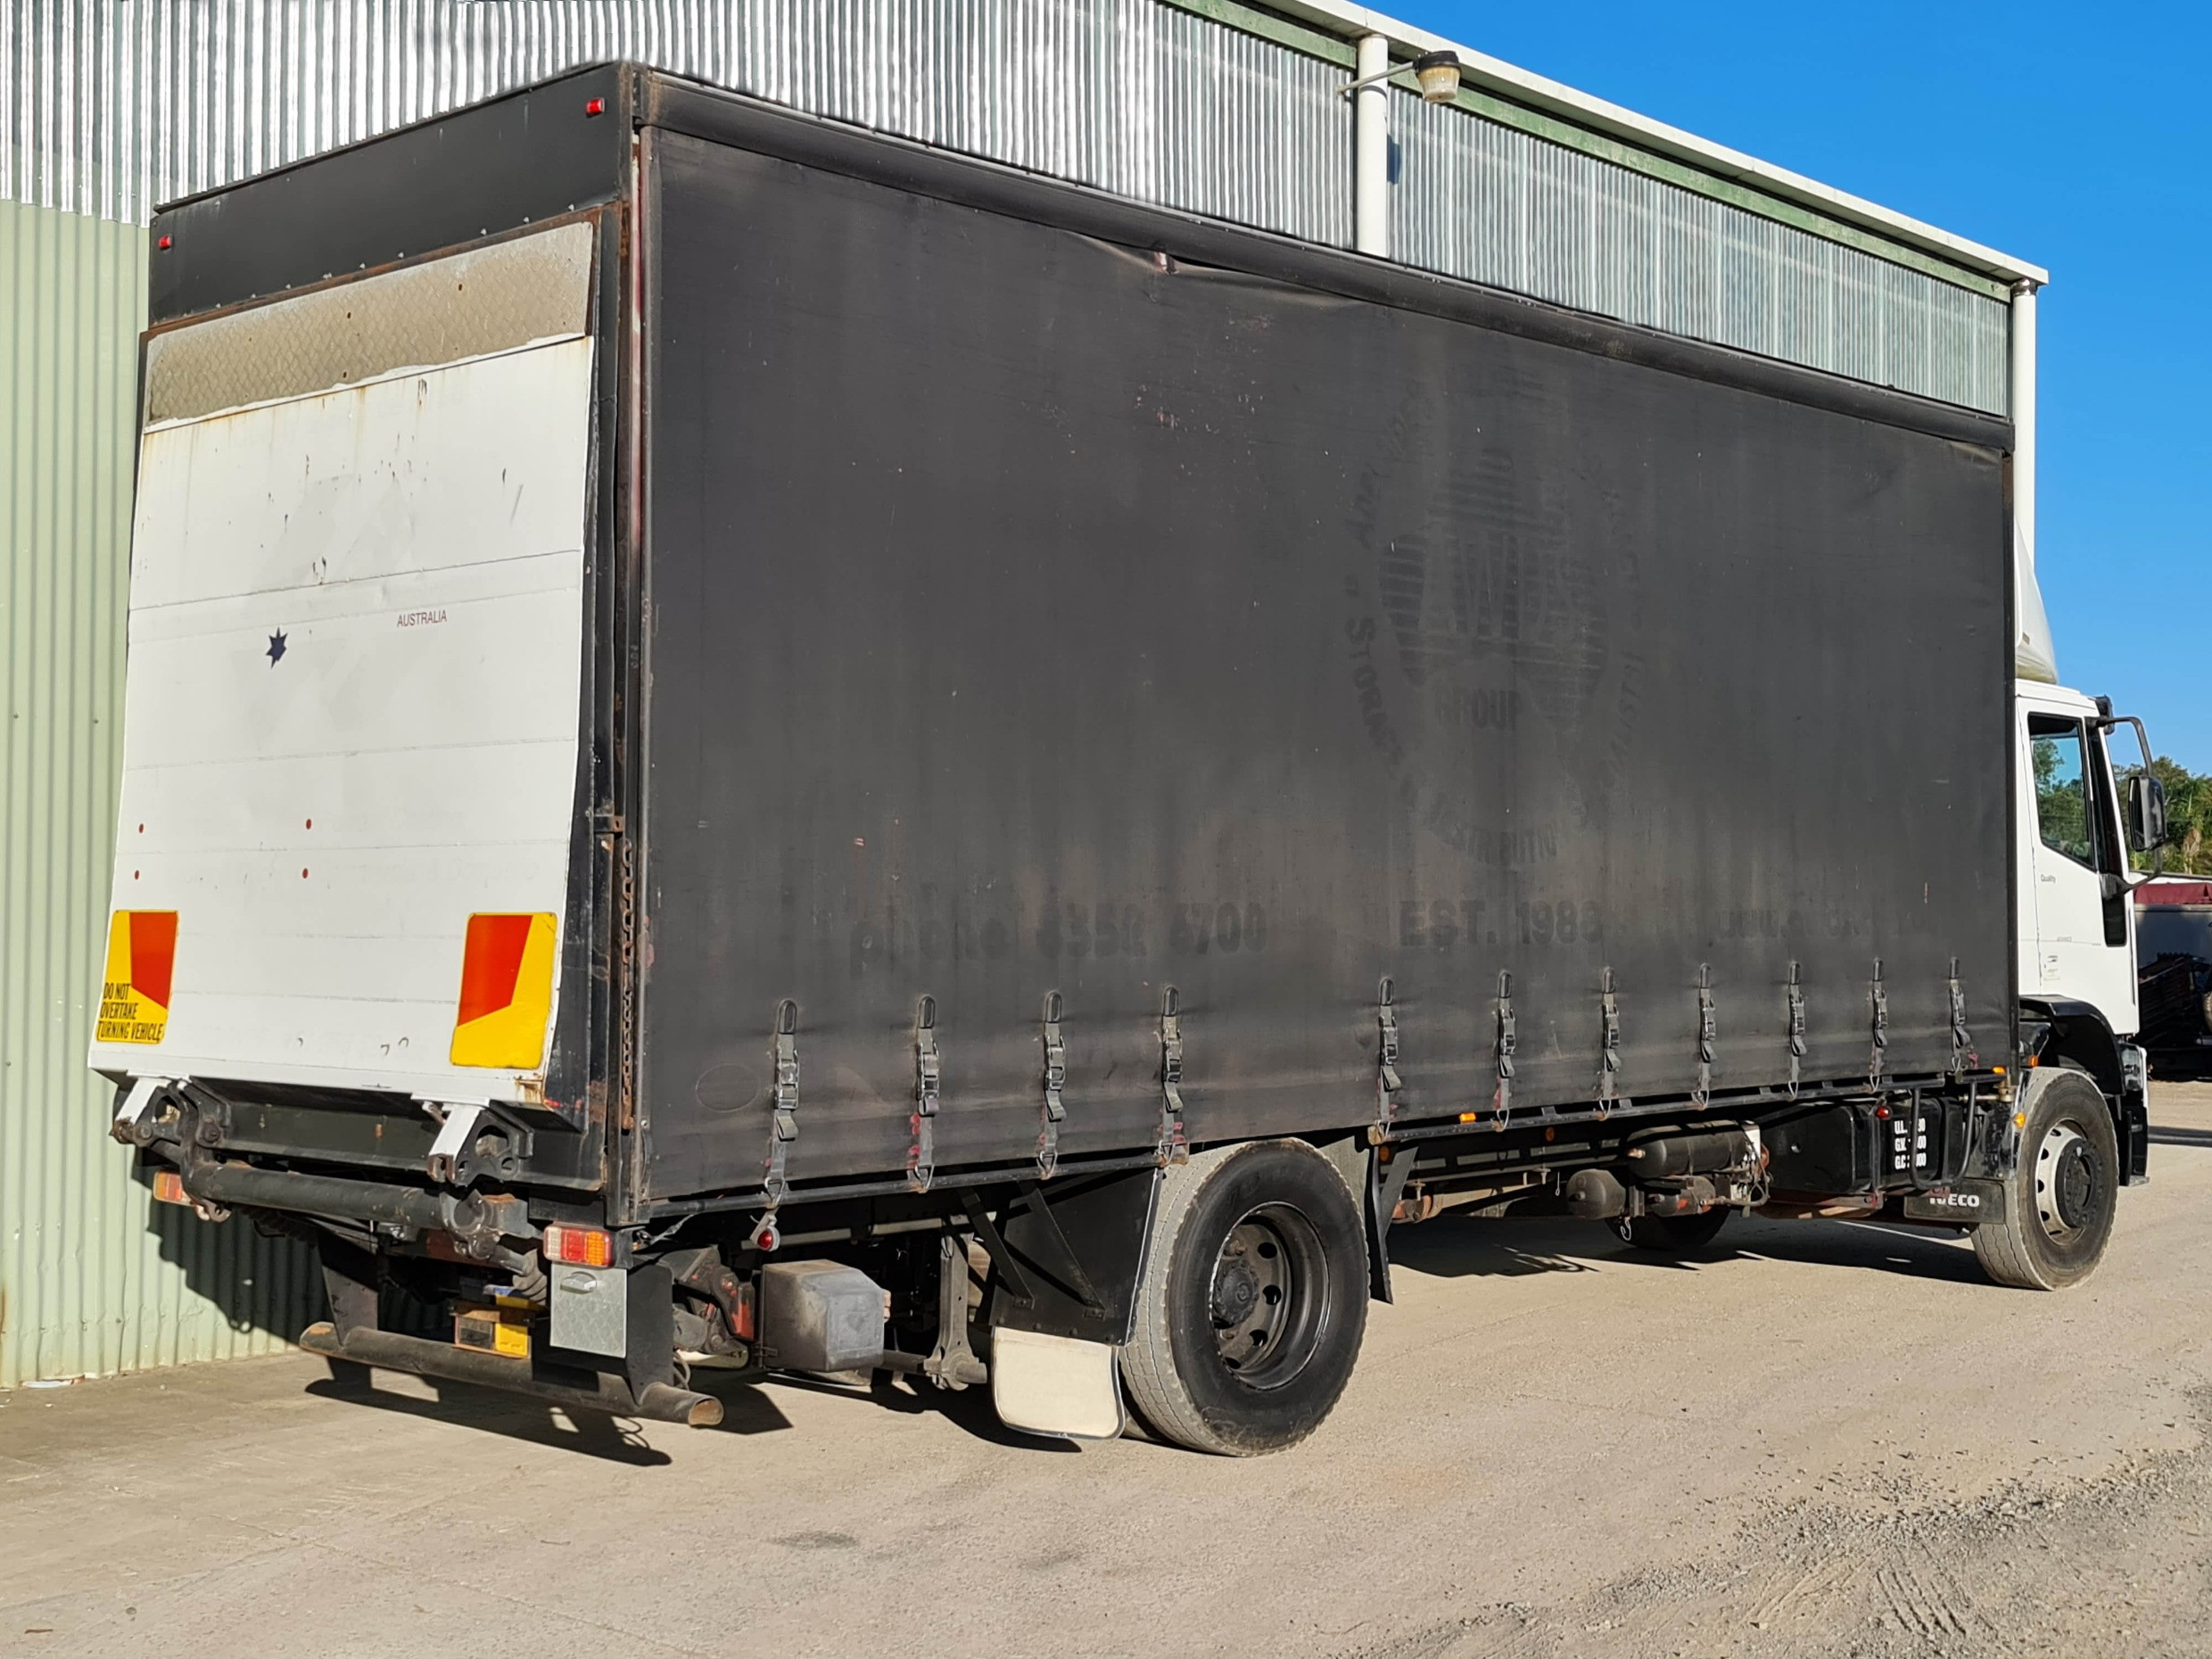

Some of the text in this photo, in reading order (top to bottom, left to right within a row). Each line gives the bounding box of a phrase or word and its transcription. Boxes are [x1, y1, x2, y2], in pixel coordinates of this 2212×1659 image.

[397, 609, 447, 627] AUSTRALIA
[104, 982, 131, 1000] DO NOT
[100, 1002, 139, 1019] OVERTAKE
[98, 1020, 164, 1041] TURNING VEHICLE
[1929, 1193, 1980, 1208] IVECO
